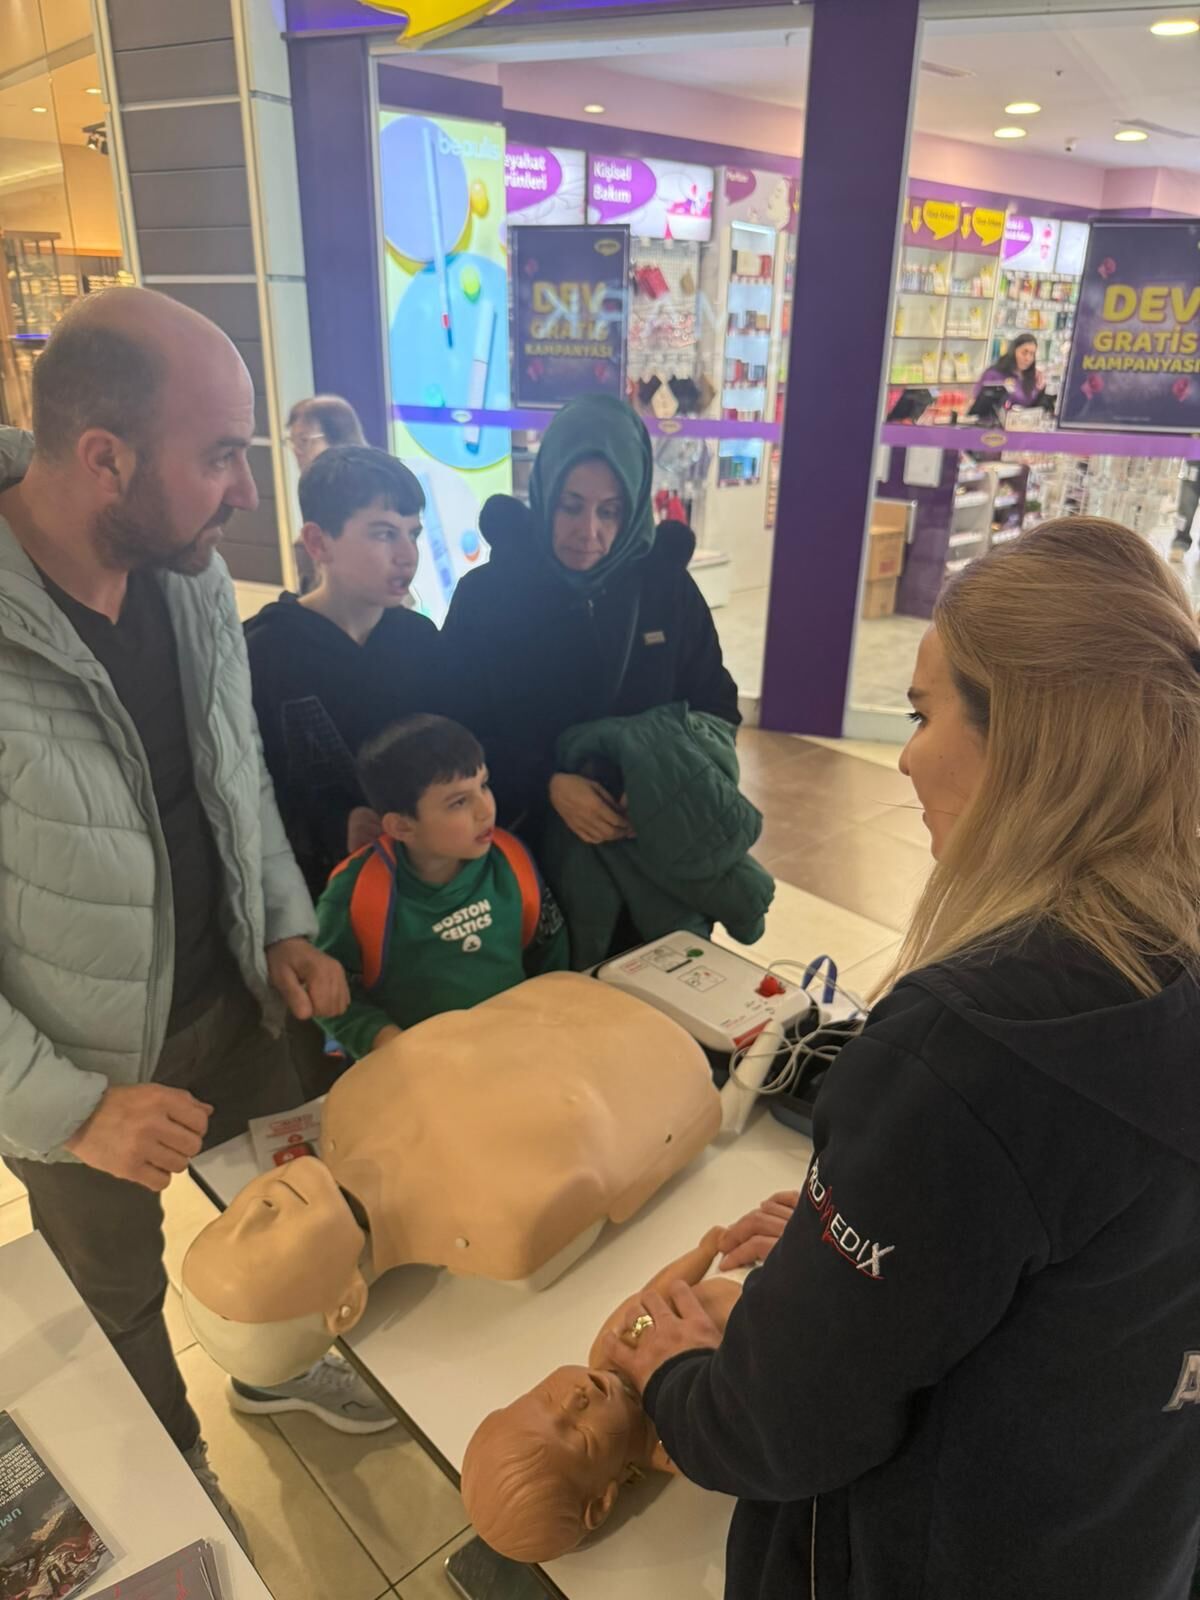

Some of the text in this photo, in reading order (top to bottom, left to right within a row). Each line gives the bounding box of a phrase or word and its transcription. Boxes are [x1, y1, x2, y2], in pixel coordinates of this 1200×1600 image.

[1103, 283, 1200, 324] DEV
[1081, 354, 1200, 374] KAMPANYASI
[0, 1506, 22, 1529] UM
